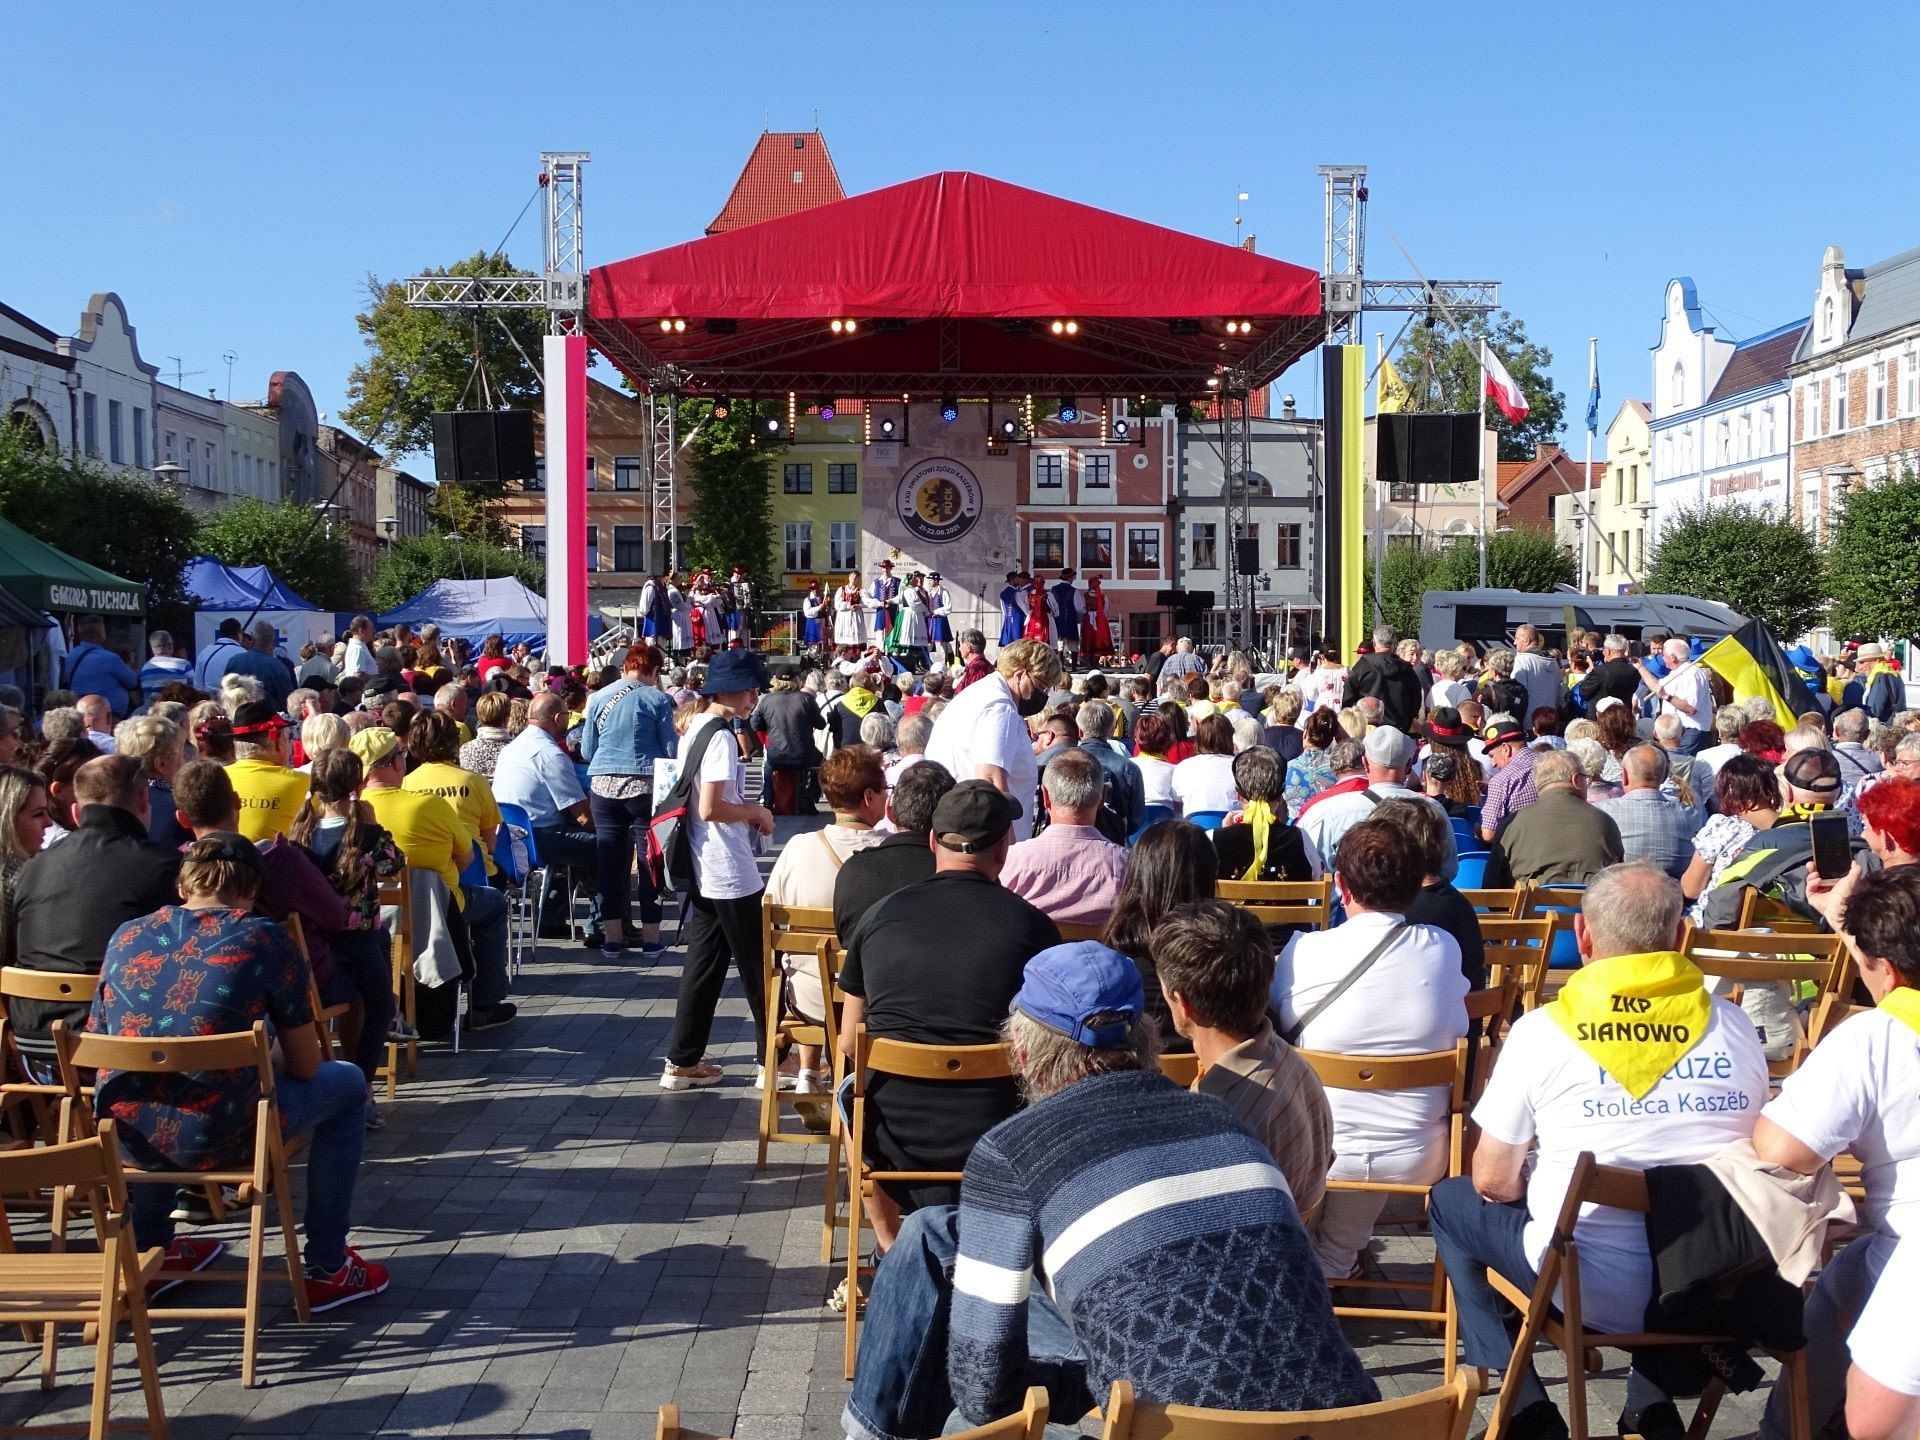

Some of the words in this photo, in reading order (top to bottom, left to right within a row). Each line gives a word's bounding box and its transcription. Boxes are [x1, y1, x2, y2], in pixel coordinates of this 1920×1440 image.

[50, 584, 88, 607] GMINA
[90, 589, 140, 610] TUCHOLA
[1611, 994, 1652, 1013] ZKP
[1577, 1022, 1690, 1044] SIANOWO
[1678, 1091, 1749, 1112] Kaszëb
[350, 1266, 367, 1288] N
